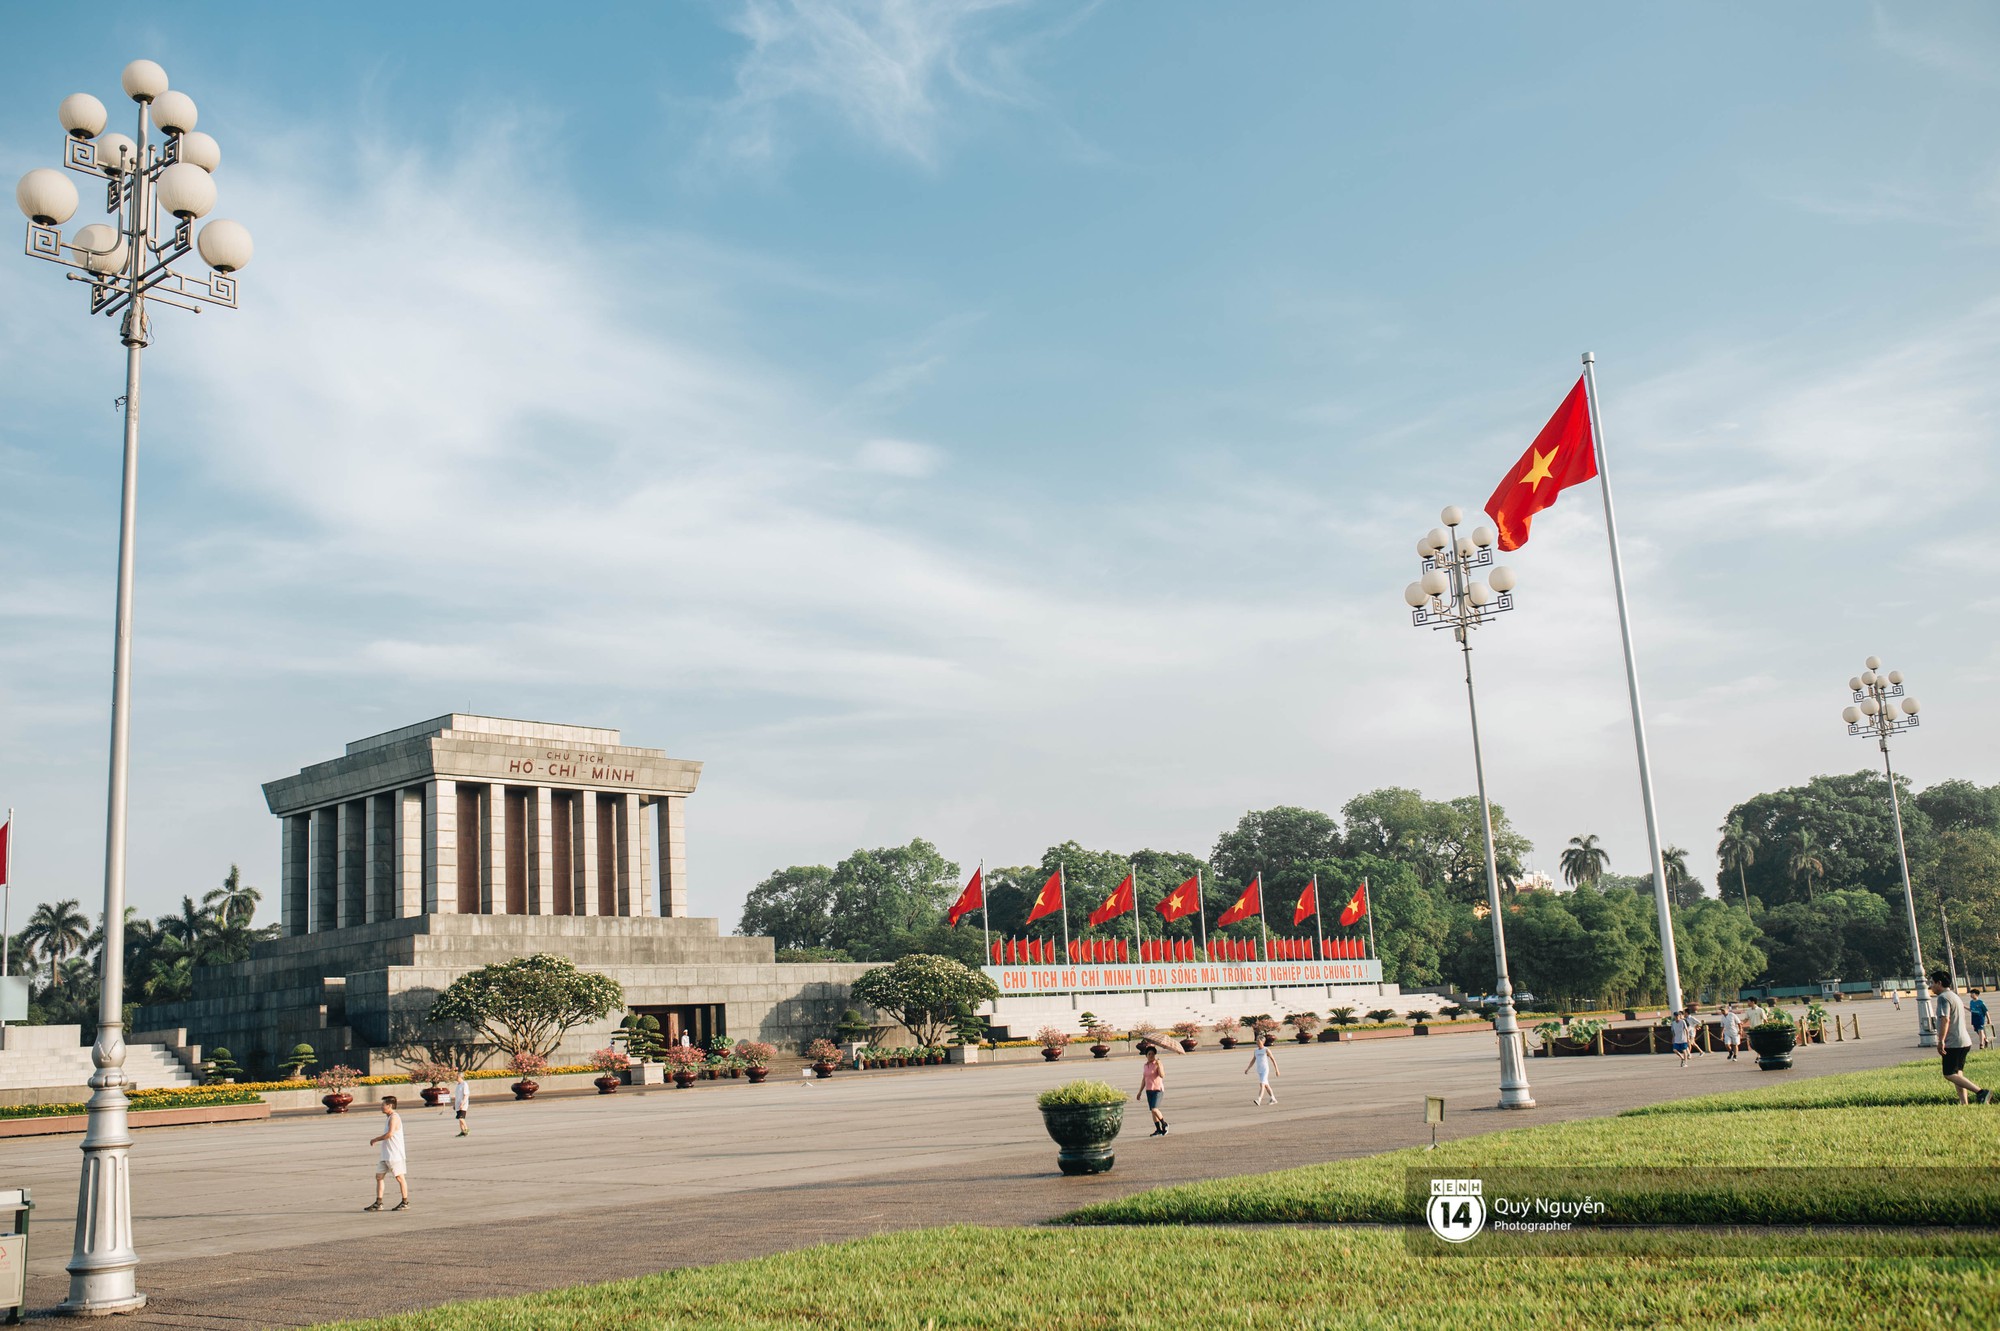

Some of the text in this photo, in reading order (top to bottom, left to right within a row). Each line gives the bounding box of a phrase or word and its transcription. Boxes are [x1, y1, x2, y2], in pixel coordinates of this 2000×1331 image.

[1003, 966, 1027, 989] CHỦ
[1031, 970, 1058, 991] TỊCH
[1061, 966, 1077, 988] HỒ
[1081, 967, 1100, 987] CHÍ
[1104, 969, 1132, 986] MINH
[1136, 966, 1146, 986] VĨ
[1149, 969, 1168, 988] ĐẠI
[1171, 964, 1198, 985] SỐNG
[1201, 965, 1220, 983] MÃI
[1222, 967, 1253, 983] TRONG
[1255, 965, 1268, 984] SỰ
[1270, 963, 1302, 983] NGHIỆP
[1304, 962, 1321, 980] CỦA
[1323, 963, 1351, 980] CHÚNG
[1352, 965, 1363, 979] TA
